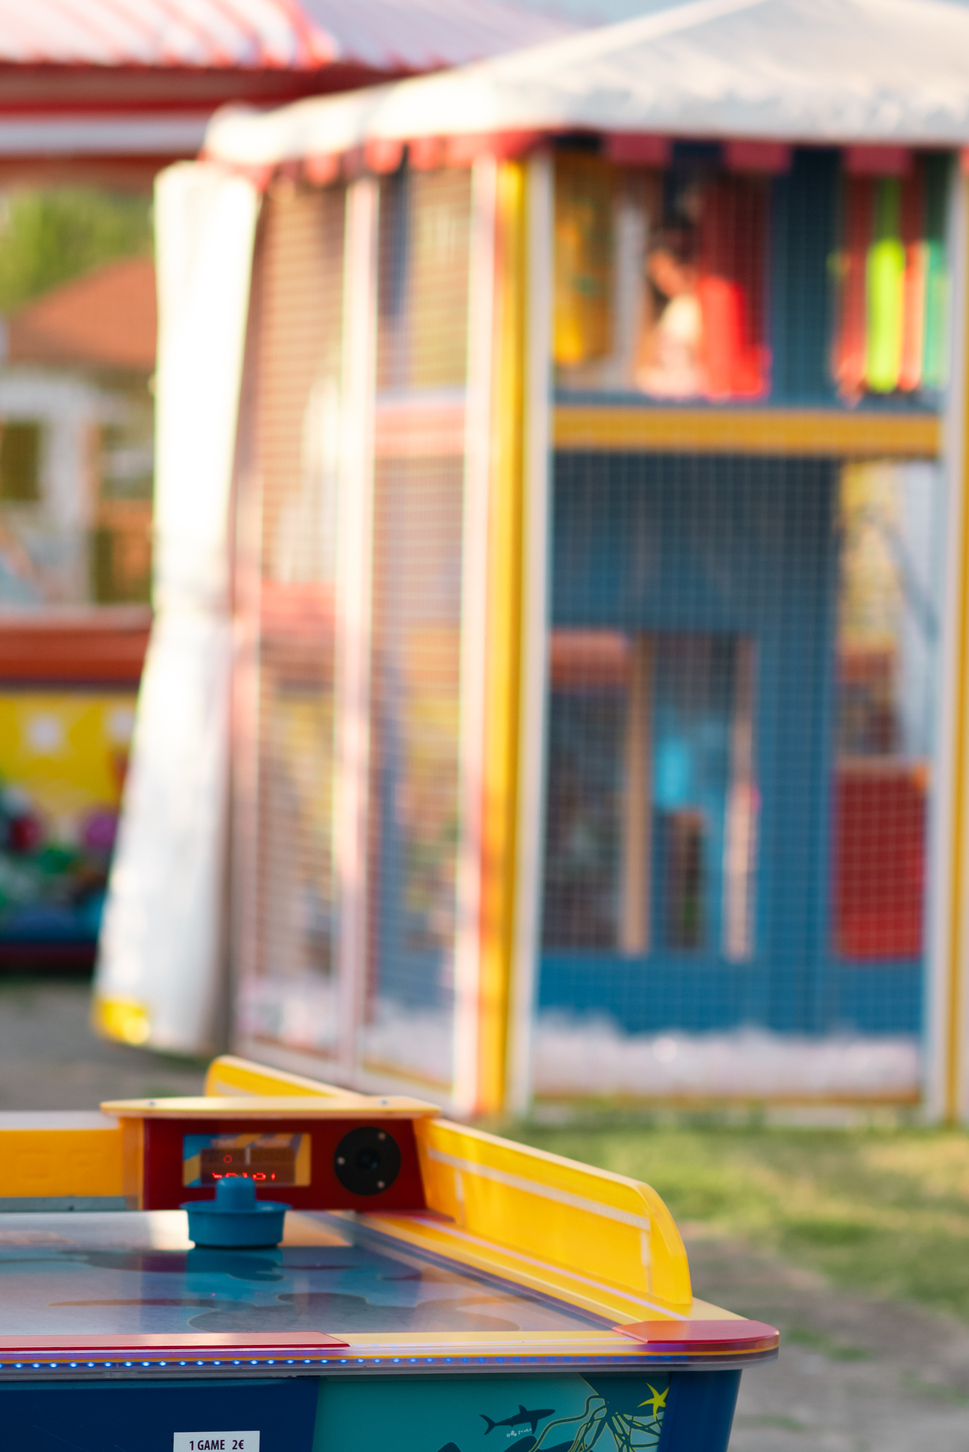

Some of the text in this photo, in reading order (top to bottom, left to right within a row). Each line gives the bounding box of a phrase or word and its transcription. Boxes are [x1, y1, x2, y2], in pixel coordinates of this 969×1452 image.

[189, 1439, 244, 1450] 1 GAME 2€
